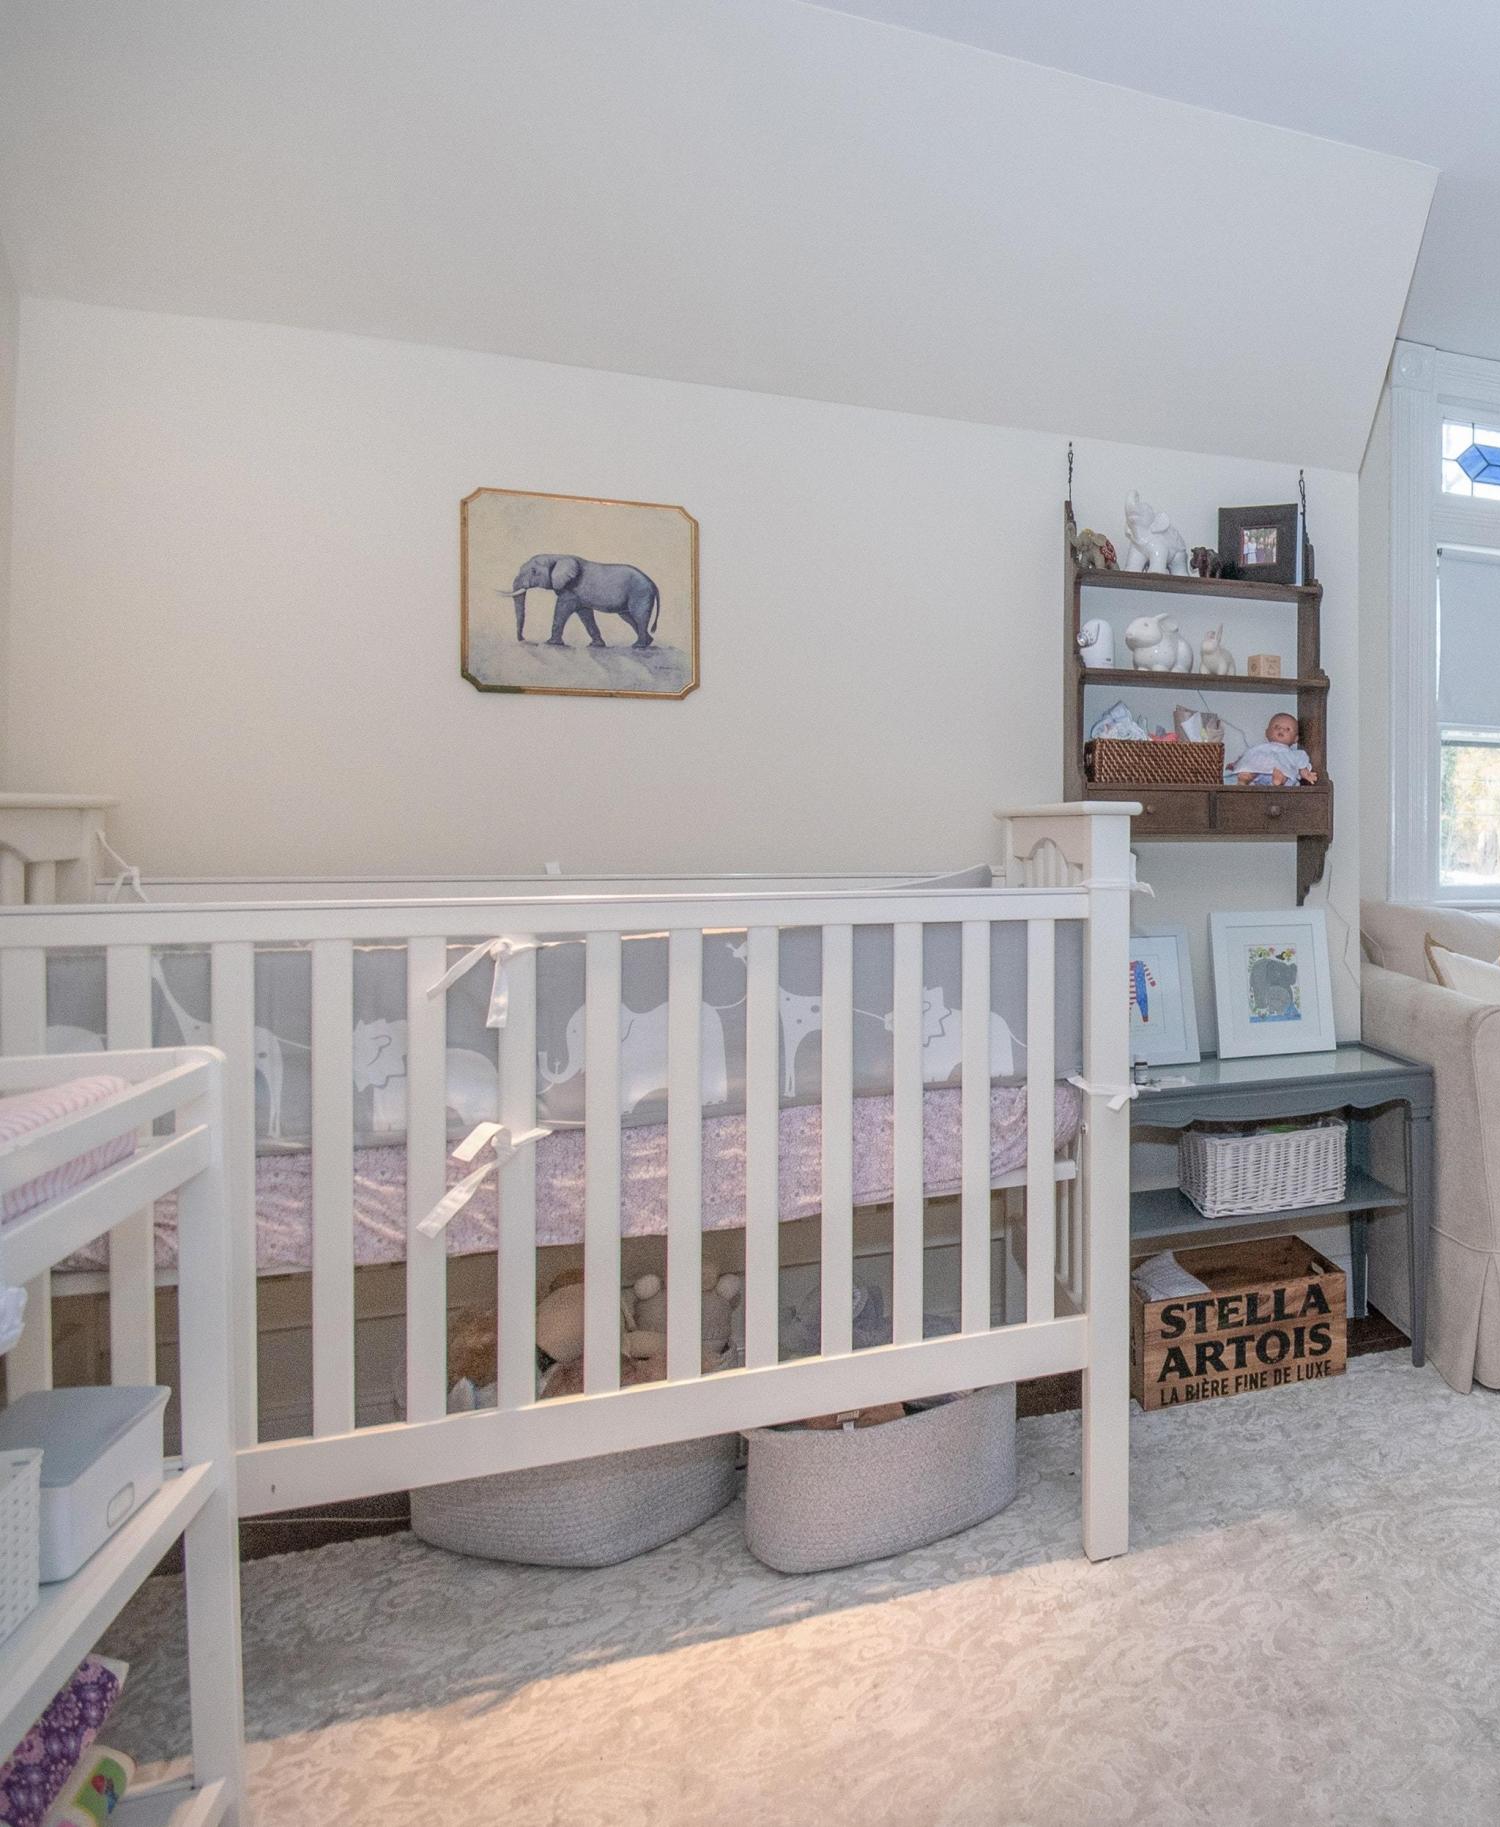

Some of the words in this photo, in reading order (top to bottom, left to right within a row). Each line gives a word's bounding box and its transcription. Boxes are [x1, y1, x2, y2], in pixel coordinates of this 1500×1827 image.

[1160, 1283, 1332, 1339] STELLA
[1157, 1322, 1333, 1383] ARTOIS
[1160, 1389, 1179, 1406] LA
[1185, 1377, 1229, 1401] BIÈRE
[1235, 1371, 1268, 1392] FINE
[1273, 1368, 1292, 1385] DE
[1297, 1360, 1332, 1382] LUXE
